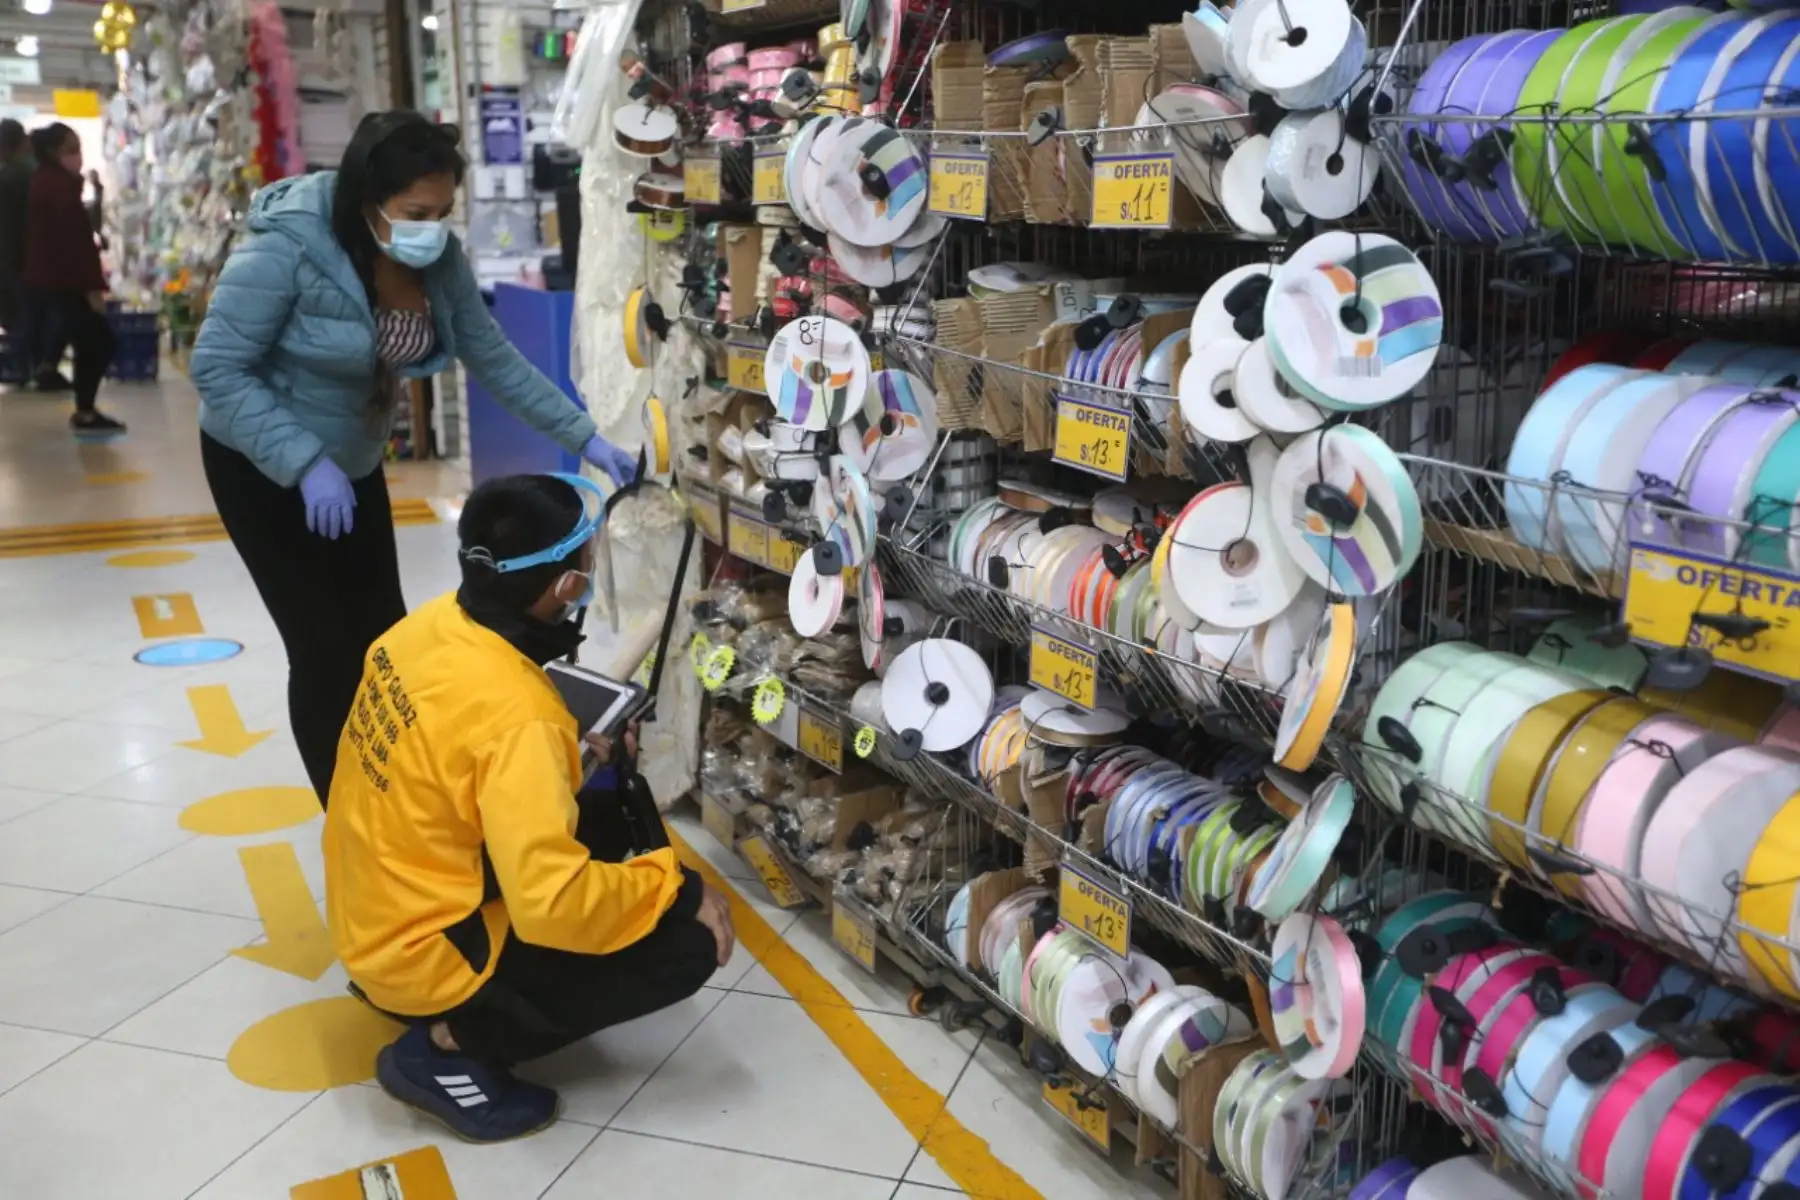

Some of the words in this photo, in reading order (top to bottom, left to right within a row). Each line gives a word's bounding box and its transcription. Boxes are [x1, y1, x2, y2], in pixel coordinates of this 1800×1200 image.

[945, 162, 985, 176] OFERTA
[1114, 161, 1169, 180] OFERTA
[1076, 407, 1127, 433] OFERTA
[1677, 565, 1800, 608] OFERTA
[1048, 640, 1094, 669] OFERTA
[1078, 880, 1127, 918] OFERTA
